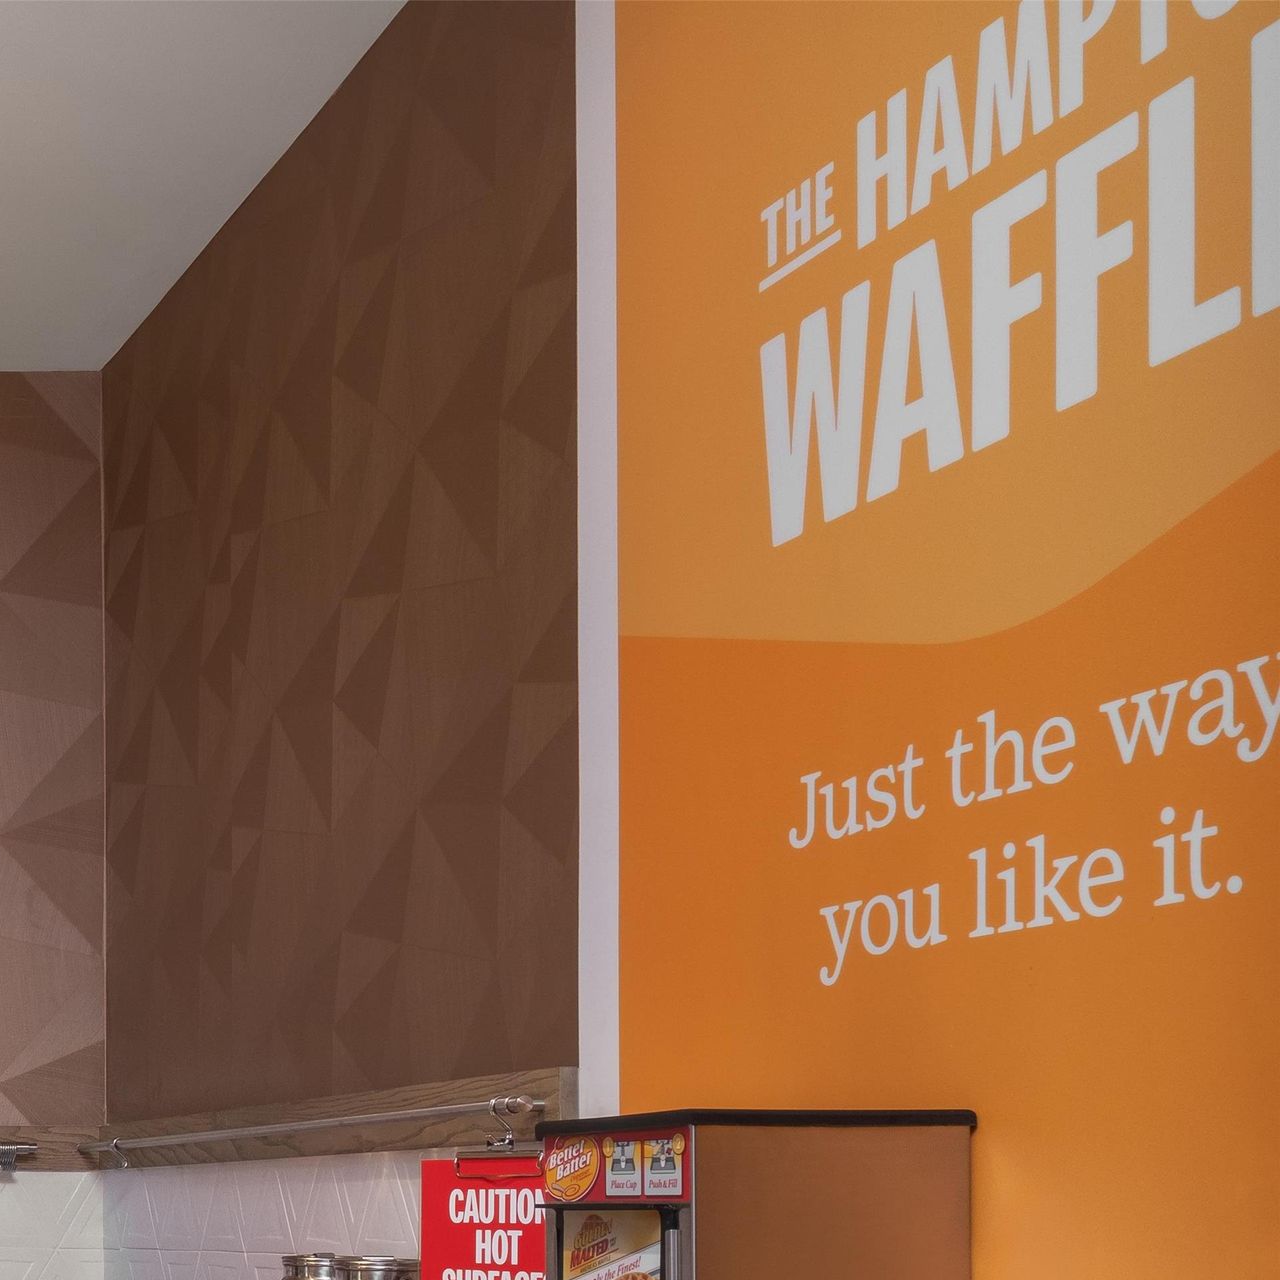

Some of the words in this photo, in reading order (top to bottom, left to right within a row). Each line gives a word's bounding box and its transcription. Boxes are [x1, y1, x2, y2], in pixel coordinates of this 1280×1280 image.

[760, 161, 836, 268] THE
[856, 0, 1241, 250] HAMP
[788, 744, 925, 849] Just
[945, 710, 1076, 807] the
[1099, 654, 1280, 764] way
[819, 883, 948, 986] you
[969, 834, 1125, 938] like
[1153, 808, 1243, 907] it.
[549, 1140, 585, 1170] Better
[555, 1151, 592, 1181] Batter
[611, 1180, 625, 1189] Place
[626, 1180, 637, 1190] Cup
[649, 1179, 662, 1189] Push
[668, 1179, 678, 1188] Fill
[475, 1229, 523, 1266] HOT
[604, 1267, 616, 1280] the
[617, 1255, 642, 1276] Finest!
